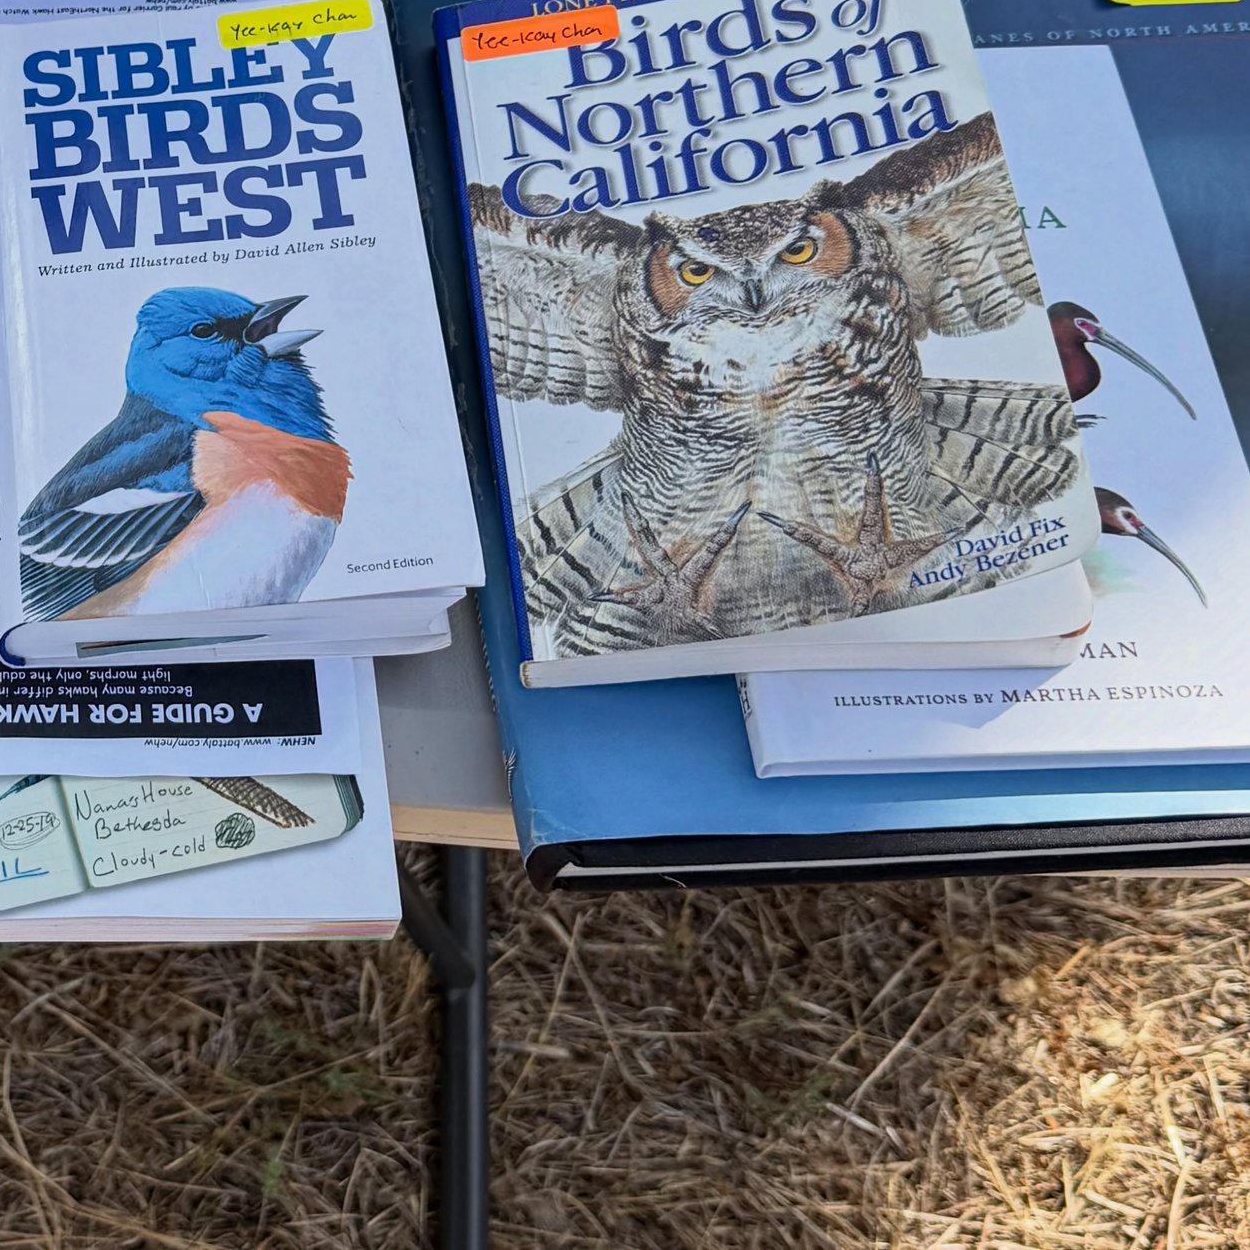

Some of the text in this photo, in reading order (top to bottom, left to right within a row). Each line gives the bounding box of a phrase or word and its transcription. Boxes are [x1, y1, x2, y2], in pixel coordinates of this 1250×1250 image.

[23, 33, 336, 107] SIBLEY
[498, 28, 941, 161] Northern
[24, 81, 362, 180] BIRDS
[501, 85, 958, 219] California
[31, 155, 366, 255] WEST
[38, 236, 377, 277] Written and Illustrated by David Allen Sibley
[954, 516, 1066, 558] David Fix
[346, 555, 434, 575] Second Edition
[908, 533, 1070, 589] Andy Bezener
[90, 703, 142, 723] FOR
[152, 702, 235, 722] GUIDE
[242, 703, 262, 722] A
[834, 683, 1224, 707] ILLUSTRATIONS BY MARTHA ESPINOZA
[141, 780, 193, 803] House
[94, 809, 187, 839] Bethesda
